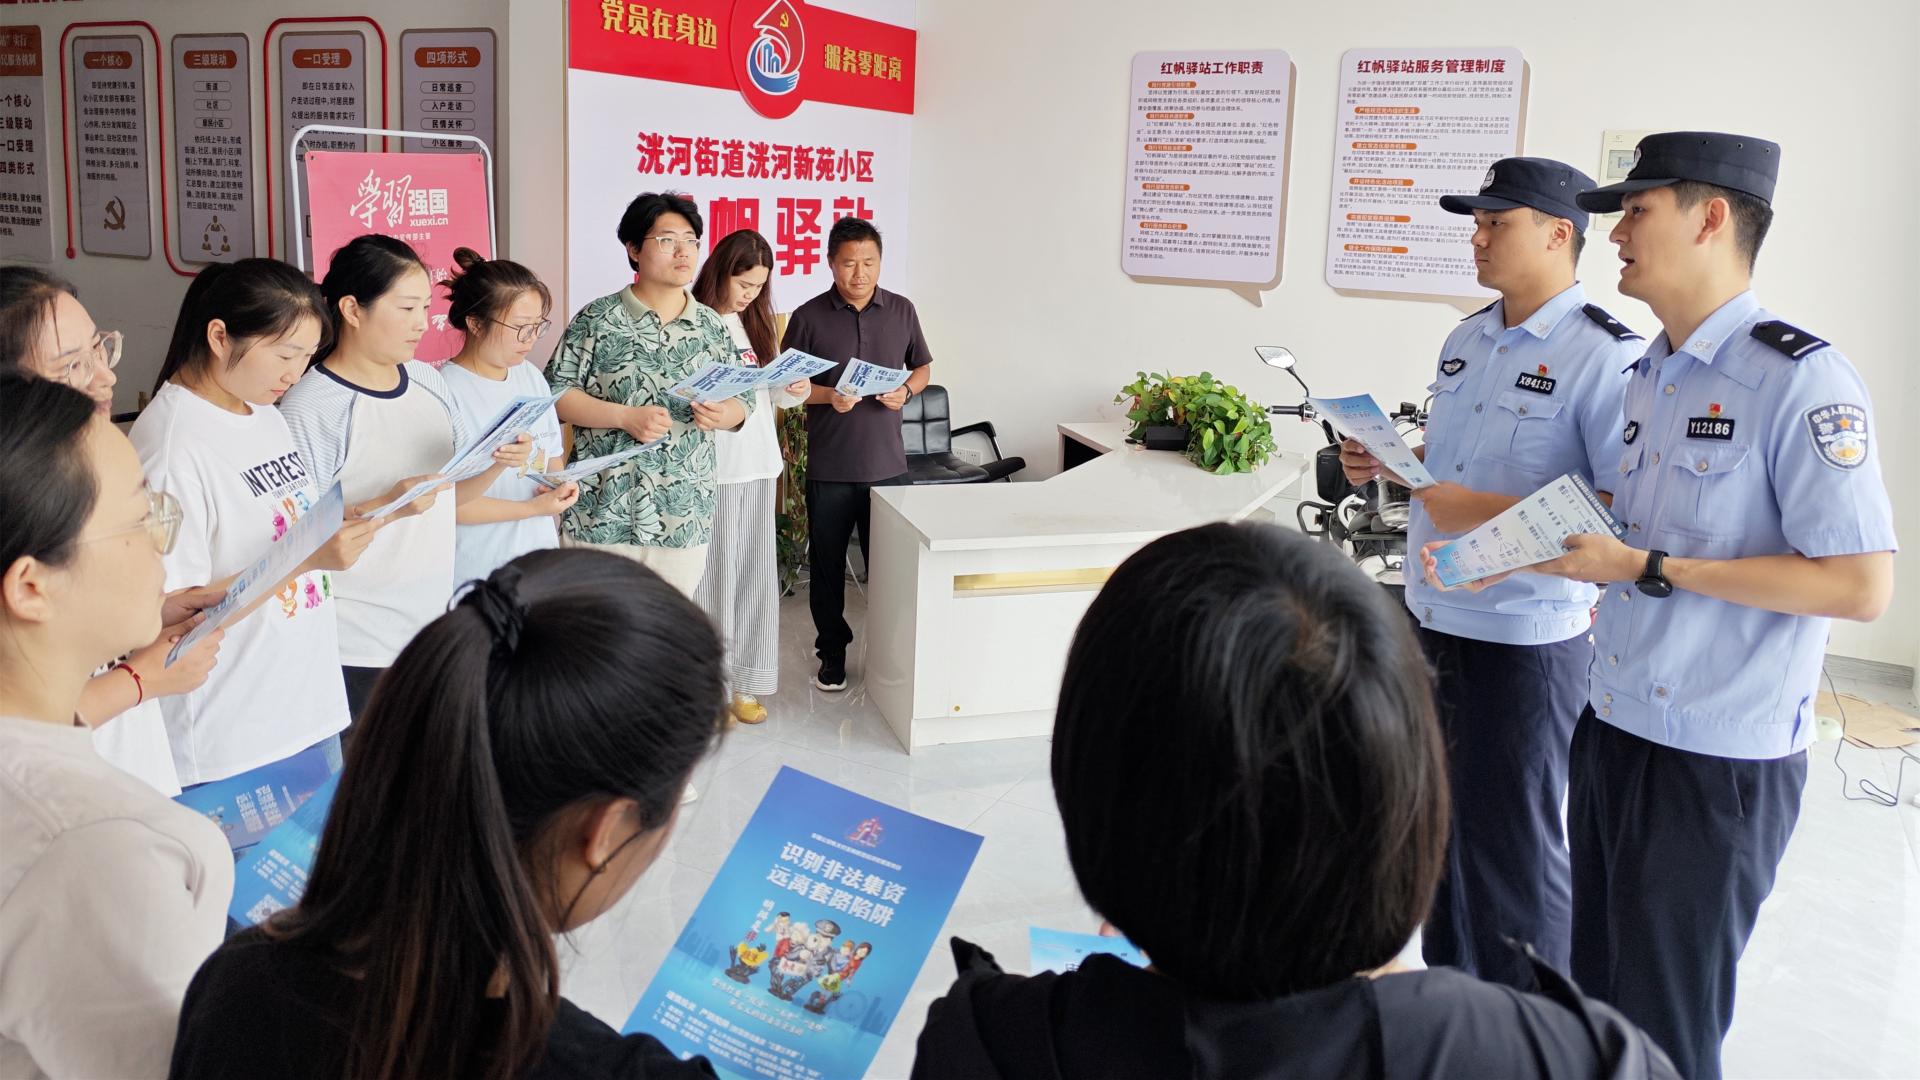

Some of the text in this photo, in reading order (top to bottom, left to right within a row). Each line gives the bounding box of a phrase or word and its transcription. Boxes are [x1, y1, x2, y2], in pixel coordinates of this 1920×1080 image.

[600, 0, 718, 49] 党员在身边
[92, 54, 124, 67] 一个核心
[193, 54, 227, 66] 三级联动
[303, 52, 341, 65] 一口受理
[426, 51, 468, 65] 四项形式
[824, 43, 902, 82] 服务零距离
[1160, 61, 1264, 75] 红帆驿站工作职责
[1357, 59, 1506, 74] 红帆驿站服务管理制度
[431, 83, 463, 92] 日常巡查
[431, 102, 463, 111] 入户走访
[432, 119, 463, 129] 民情关怀
[636, 131, 874, 183] 洸河街道洸河新苑小区
[410, 217, 448, 227] xuexi.cn
[633, 195, 874, 283] 帆驿
[1518, 375, 1553, 392] X84133
[1689, 421, 1731, 437] Y12186
[240, 451, 307, 498] INTEREST
[779, 841, 908, 905] 识别非法集资
[766, 863, 896, 929] 远离套路陷阱
